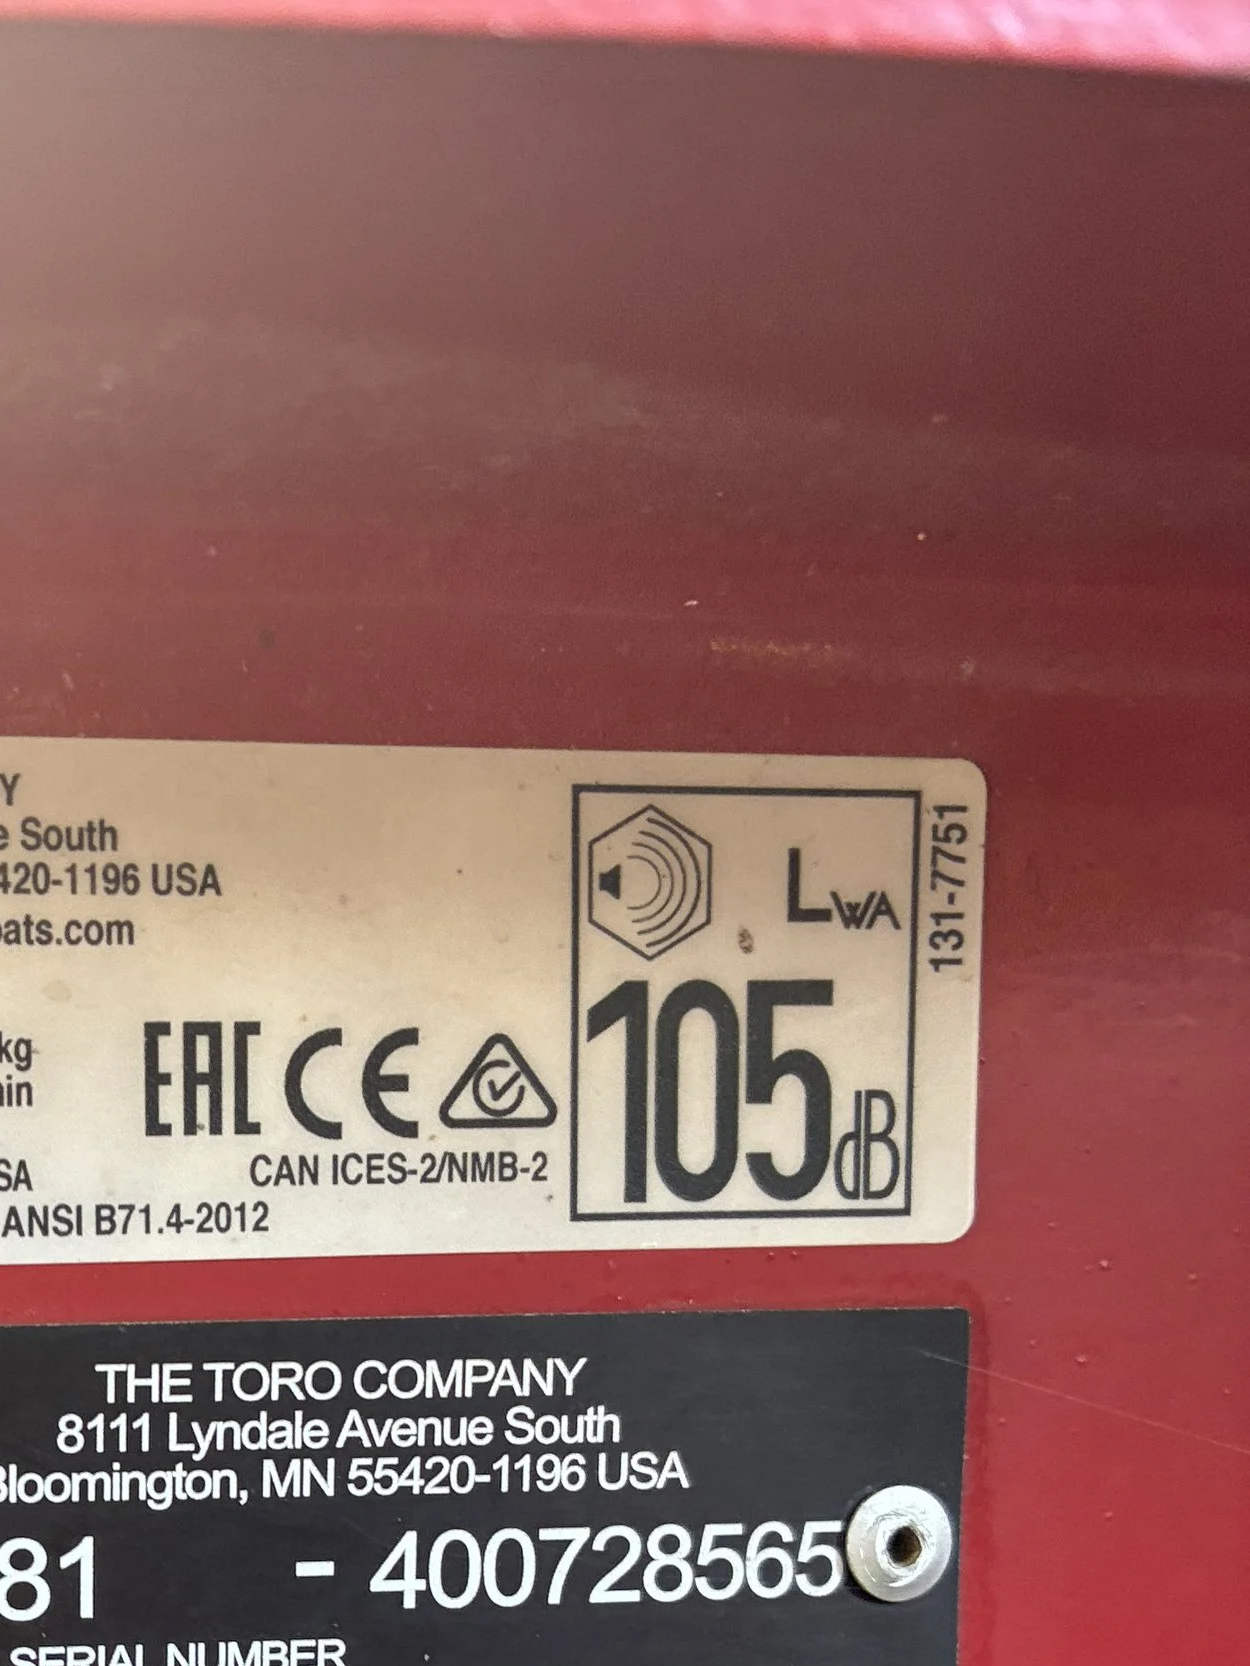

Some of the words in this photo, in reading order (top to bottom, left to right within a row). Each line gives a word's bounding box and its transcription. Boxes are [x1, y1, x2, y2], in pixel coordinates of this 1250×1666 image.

[20, 815, 118, 852] South
[151, 861, 223, 897] USA
[928, 804, 969, 973] 131-7751
[283, 1026, 420, 1141] CE
[586, 978, 835, 1204] 105
[833, 1088, 901, 1201] dB
[249, 1153, 319, 1188] CAN
[331, 1150, 548, 1186] ICES-2/NMB-2
[1, 1203, 83, 1238] ANSI
[94, 1200, 269, 1236] B71.4-2012
[94, 1362, 193, 1404] THE
[202, 1360, 342, 1402] TORO
[353, 1357, 588, 1400] COMPANY
[56, 1412, 150, 1454] 8111
[168, 1410, 330, 1462] Lyndale
[335, 1408, 495, 1449] Avenue
[504, 1404, 621, 1445] South
[262, 1457, 336, 1498] MN
[347, 1452, 587, 1497] 55420-1196
[597, 1450, 690, 1491] USA
[369, 1520, 844, 1610] 400728565
